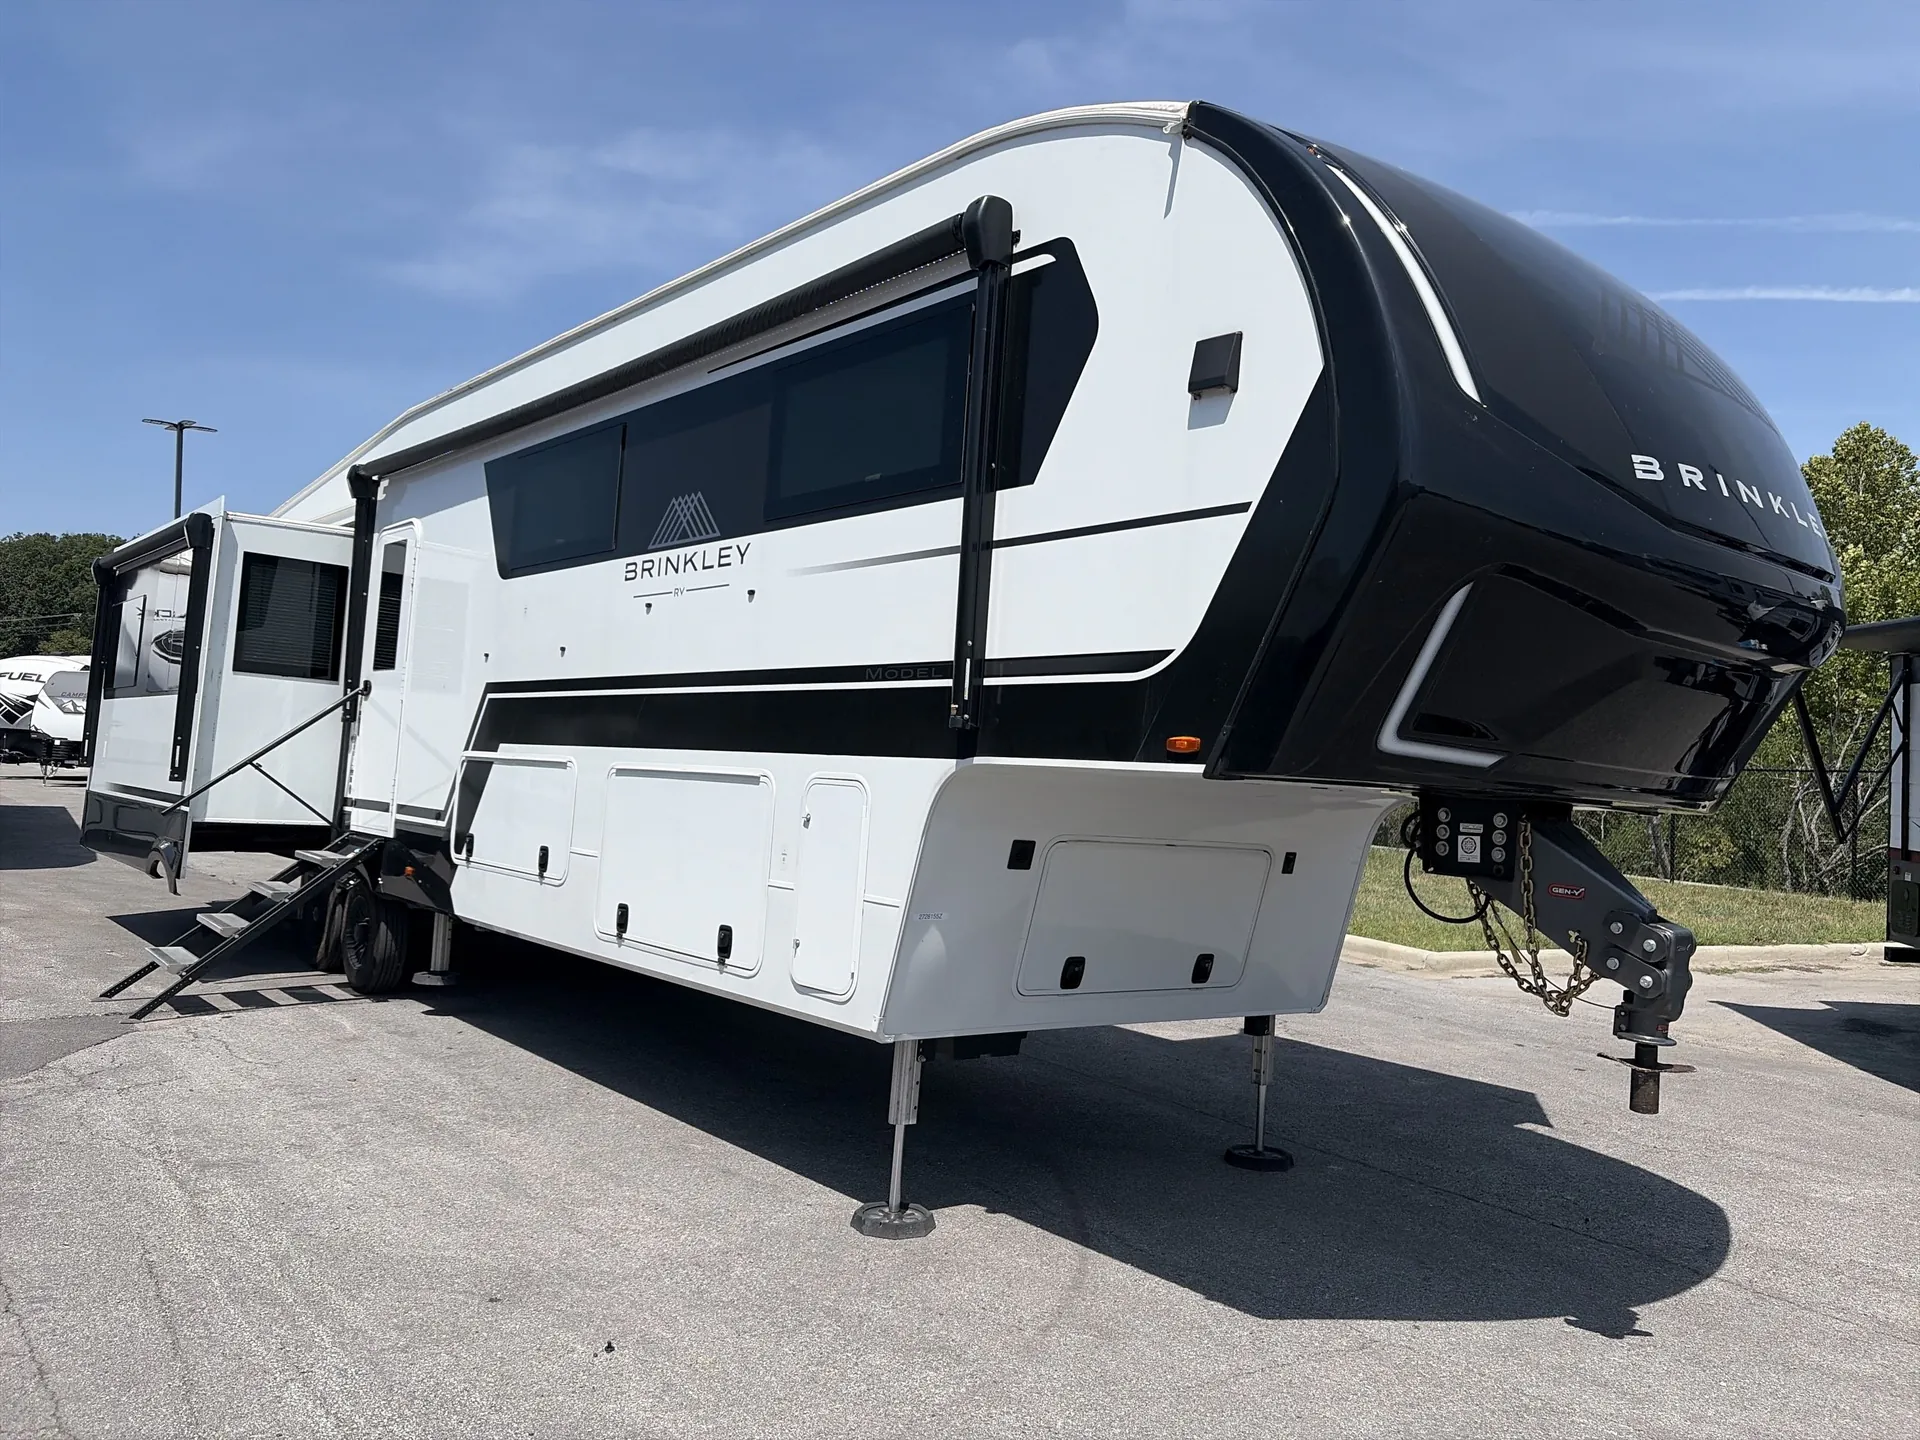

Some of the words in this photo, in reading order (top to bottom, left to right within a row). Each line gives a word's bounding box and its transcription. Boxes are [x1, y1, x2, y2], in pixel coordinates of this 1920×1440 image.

[624, 542, 751, 582] BRINKLEY
[673, 587, 686, 598] RV
[1552, 887, 1585, 896] GEN-Y
